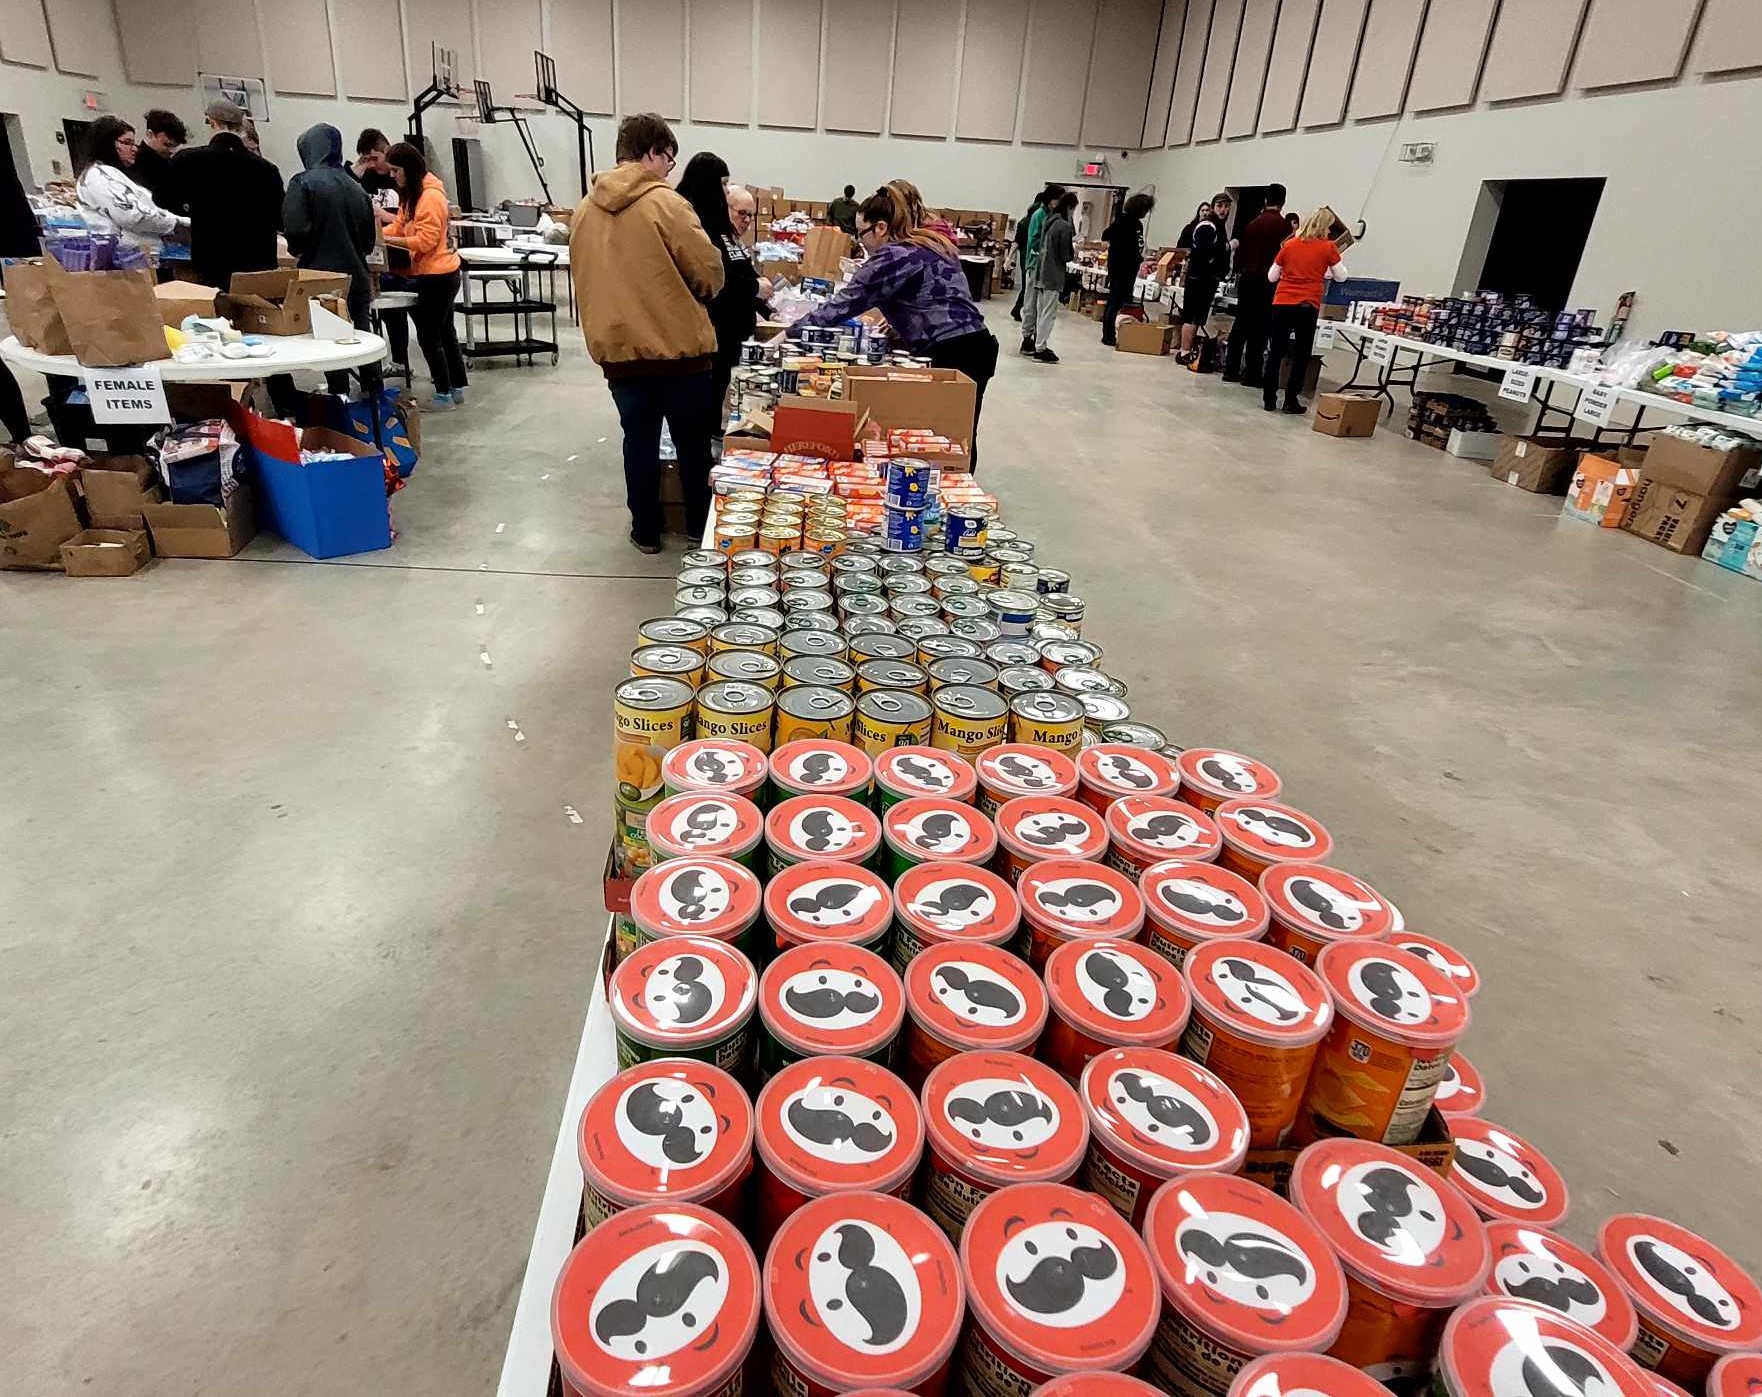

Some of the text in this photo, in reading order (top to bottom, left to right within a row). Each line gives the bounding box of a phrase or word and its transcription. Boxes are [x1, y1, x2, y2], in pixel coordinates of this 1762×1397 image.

[94, 380, 156, 391] FEMALE
[106, 399, 153, 410] ITEMS
[1675, 497, 1688, 510] 7
[632, 717, 674, 731] Slices
[730, 719, 767, 735] Slices
[938, 719, 1003, 743] Mango Sli
[1033, 729, 1078, 745] Mango
